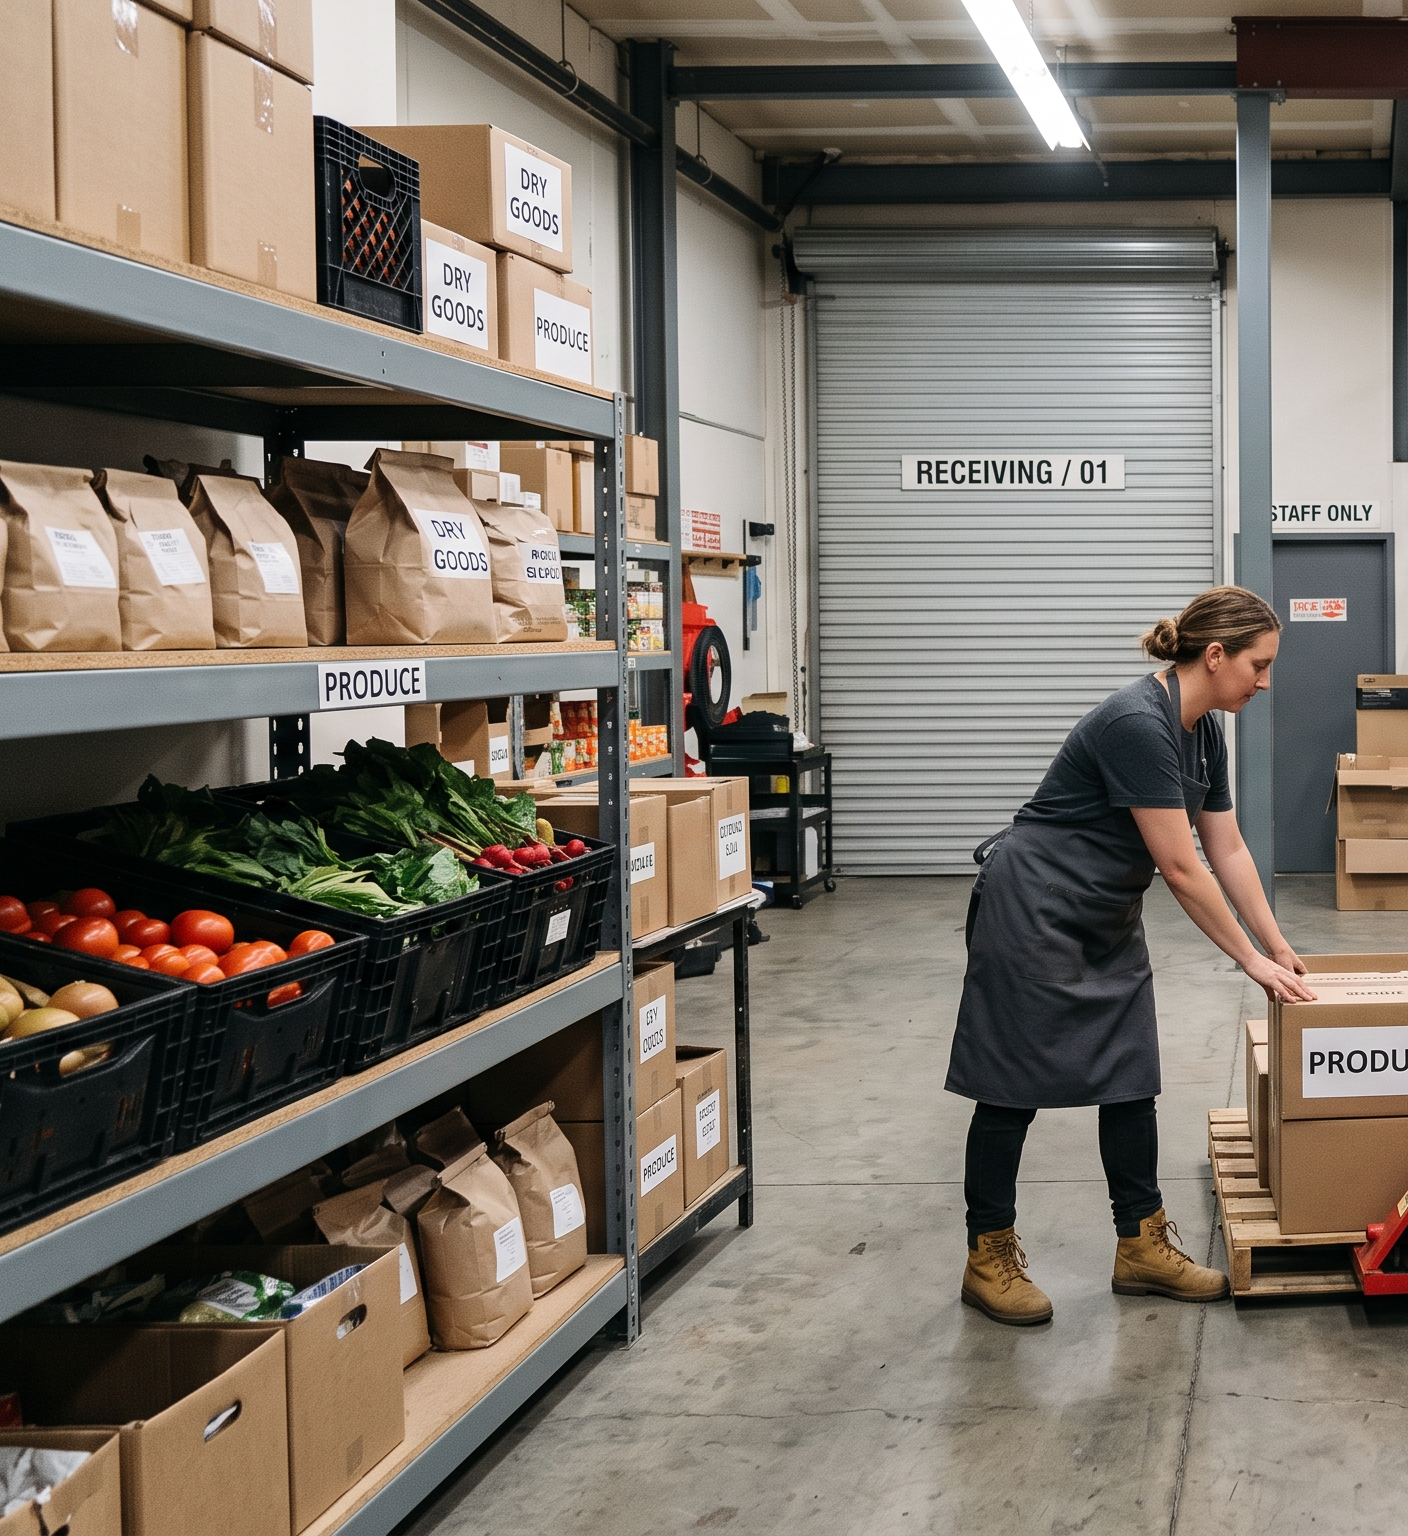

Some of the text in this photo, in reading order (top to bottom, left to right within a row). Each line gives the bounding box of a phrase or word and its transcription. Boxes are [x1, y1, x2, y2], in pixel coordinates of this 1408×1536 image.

[521, 168, 547, 198] DRY
[510, 197, 559, 235] GOODS
[443, 263, 471, 293] DRY
[432, 295, 484, 331] GOODS
[537, 316, 588, 352] PRODUCE
[917, 459, 1106, 486] RECEIVING / 01
[1272, 504, 1372, 522] STAFF ONLY
[431, 520, 466, 539] DRY
[434, 549, 488, 572] GOODS
[325, 667, 420, 702] PRODUCE
